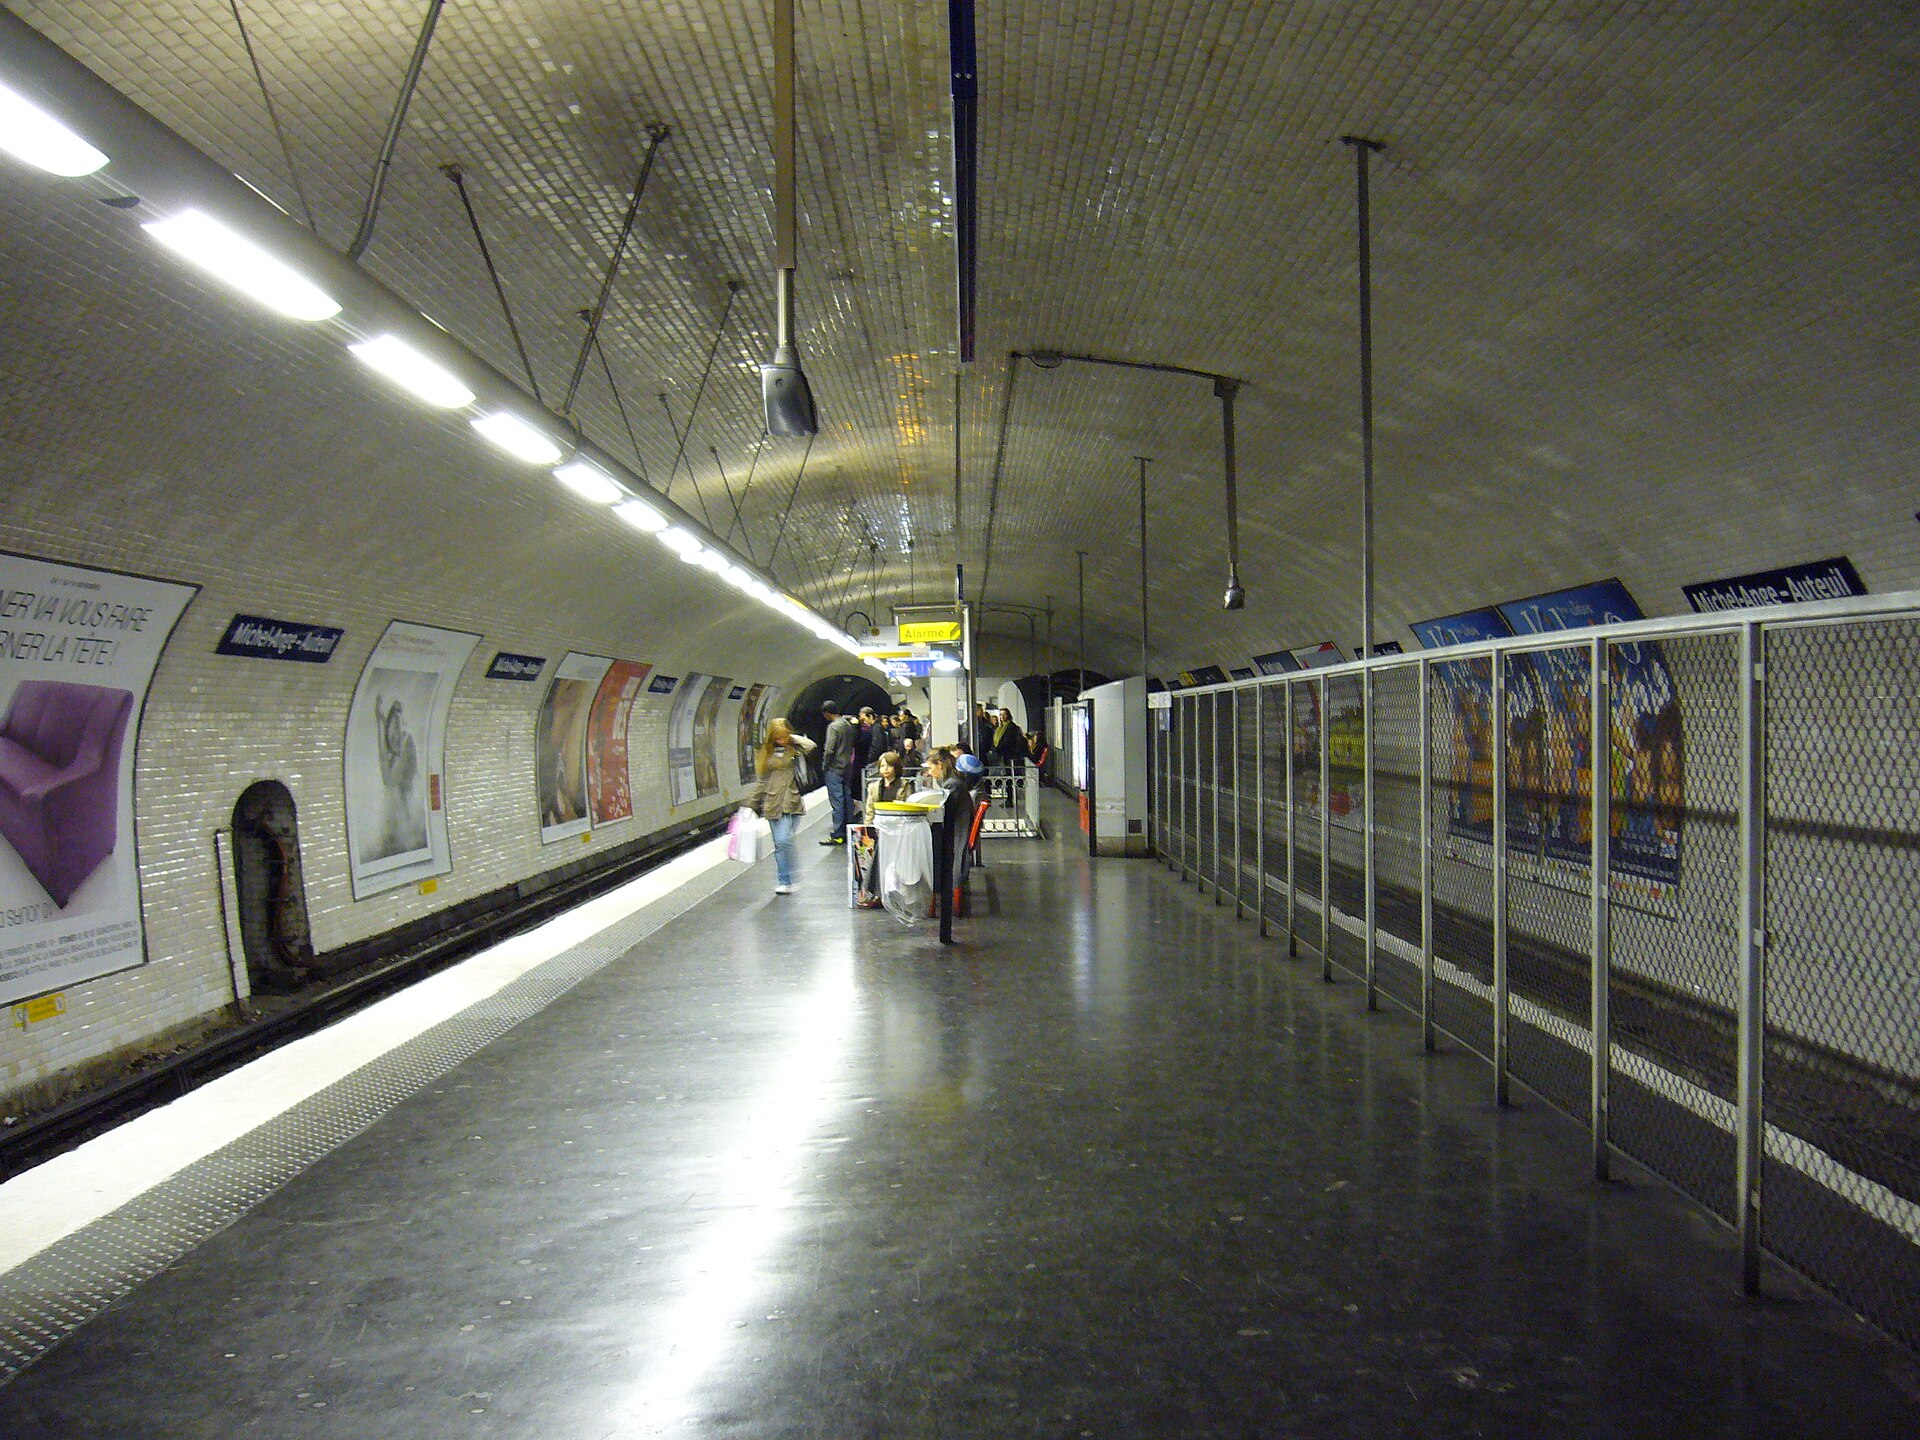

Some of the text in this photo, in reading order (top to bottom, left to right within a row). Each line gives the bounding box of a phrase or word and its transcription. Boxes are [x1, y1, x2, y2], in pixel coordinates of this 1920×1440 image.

[1785, 567, 1852, 603] Auteuil
[32, 595, 59, 622] VA
[59, 598, 110, 628] VOUS
[102, 604, 153, 632] FAIRE
[42, 635, 68, 662] LA
[905, 629, 944, 639] Alarme
